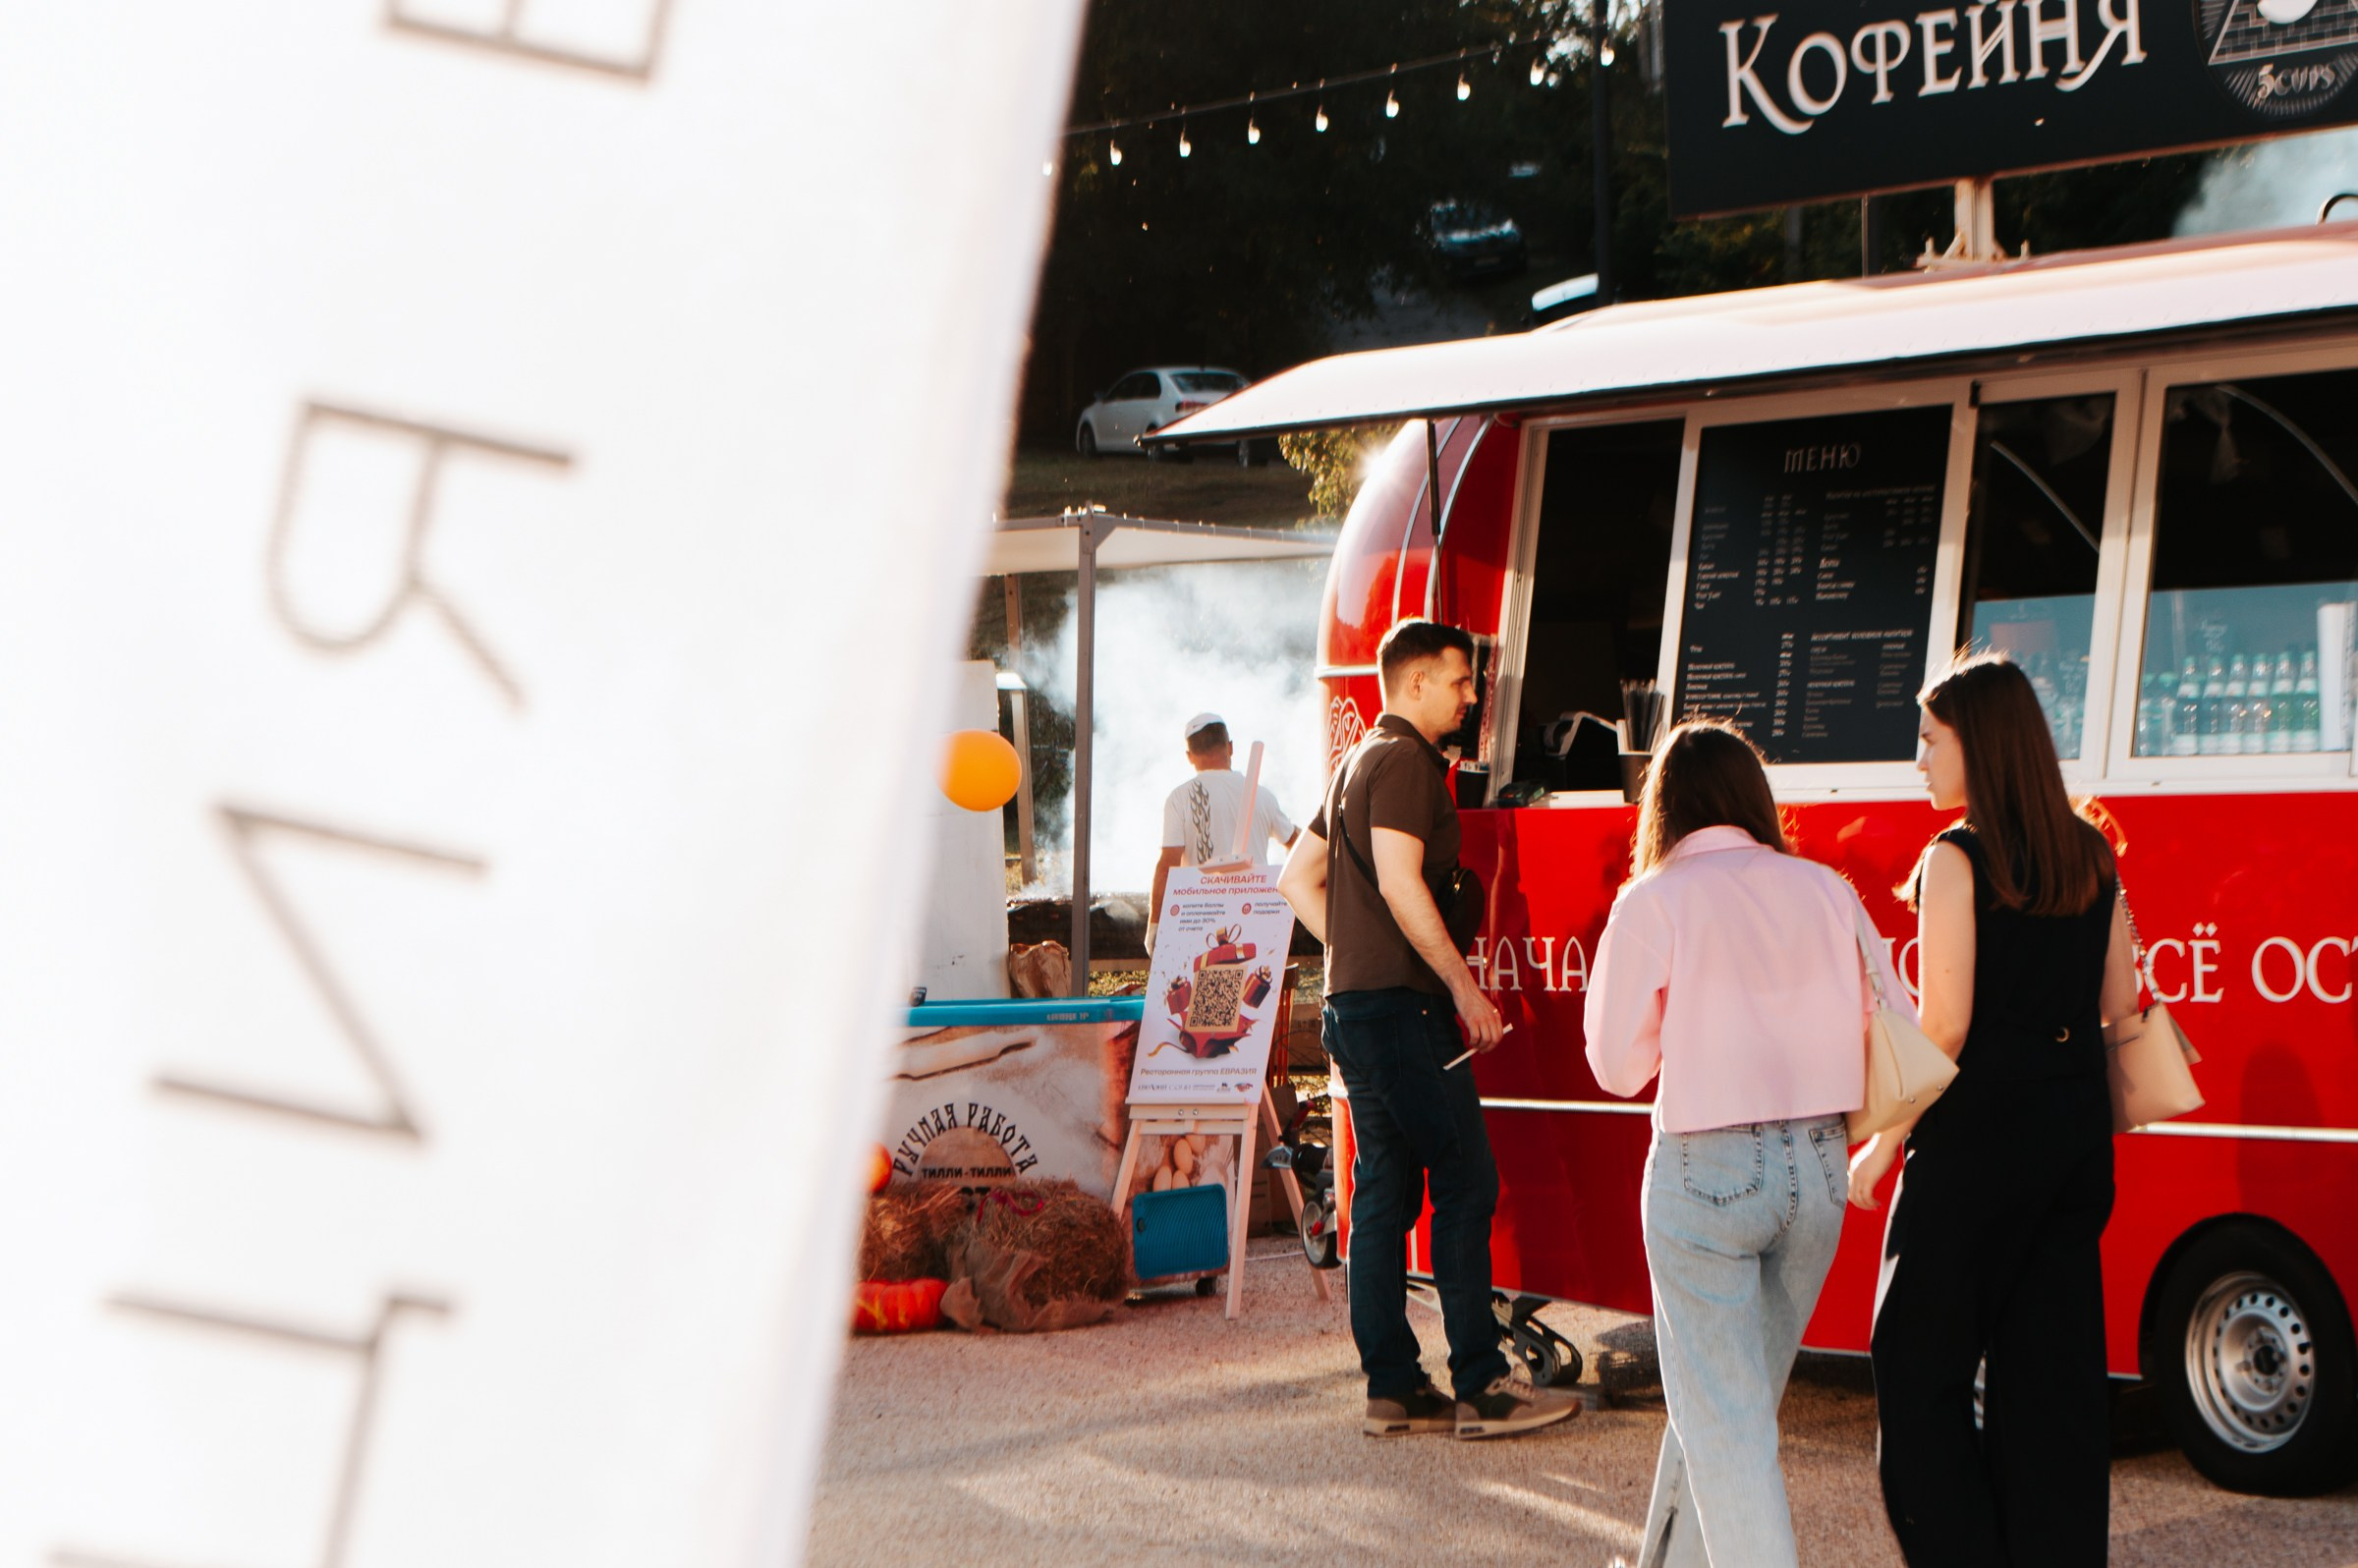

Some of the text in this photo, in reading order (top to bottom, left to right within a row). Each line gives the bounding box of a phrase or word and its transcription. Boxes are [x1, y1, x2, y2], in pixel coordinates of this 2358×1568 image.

[1784, 441, 1862, 474] МЕНЮ
[1200, 874, 1267, 885] СКАЧИВАЙТЕ
[1172, 886, 1227, 896] мобильное
[2133, 922, 2224, 1004] СЁ
[2251, 935, 2358, 1004] ОС
[1140, 1068, 1191, 1077] Ресторанная
[1219, 1067, 1258, 1076] ЕВРАЗИЯ
[892, 1102, 1039, 1177] РУЧНАЯ РАБОТА
